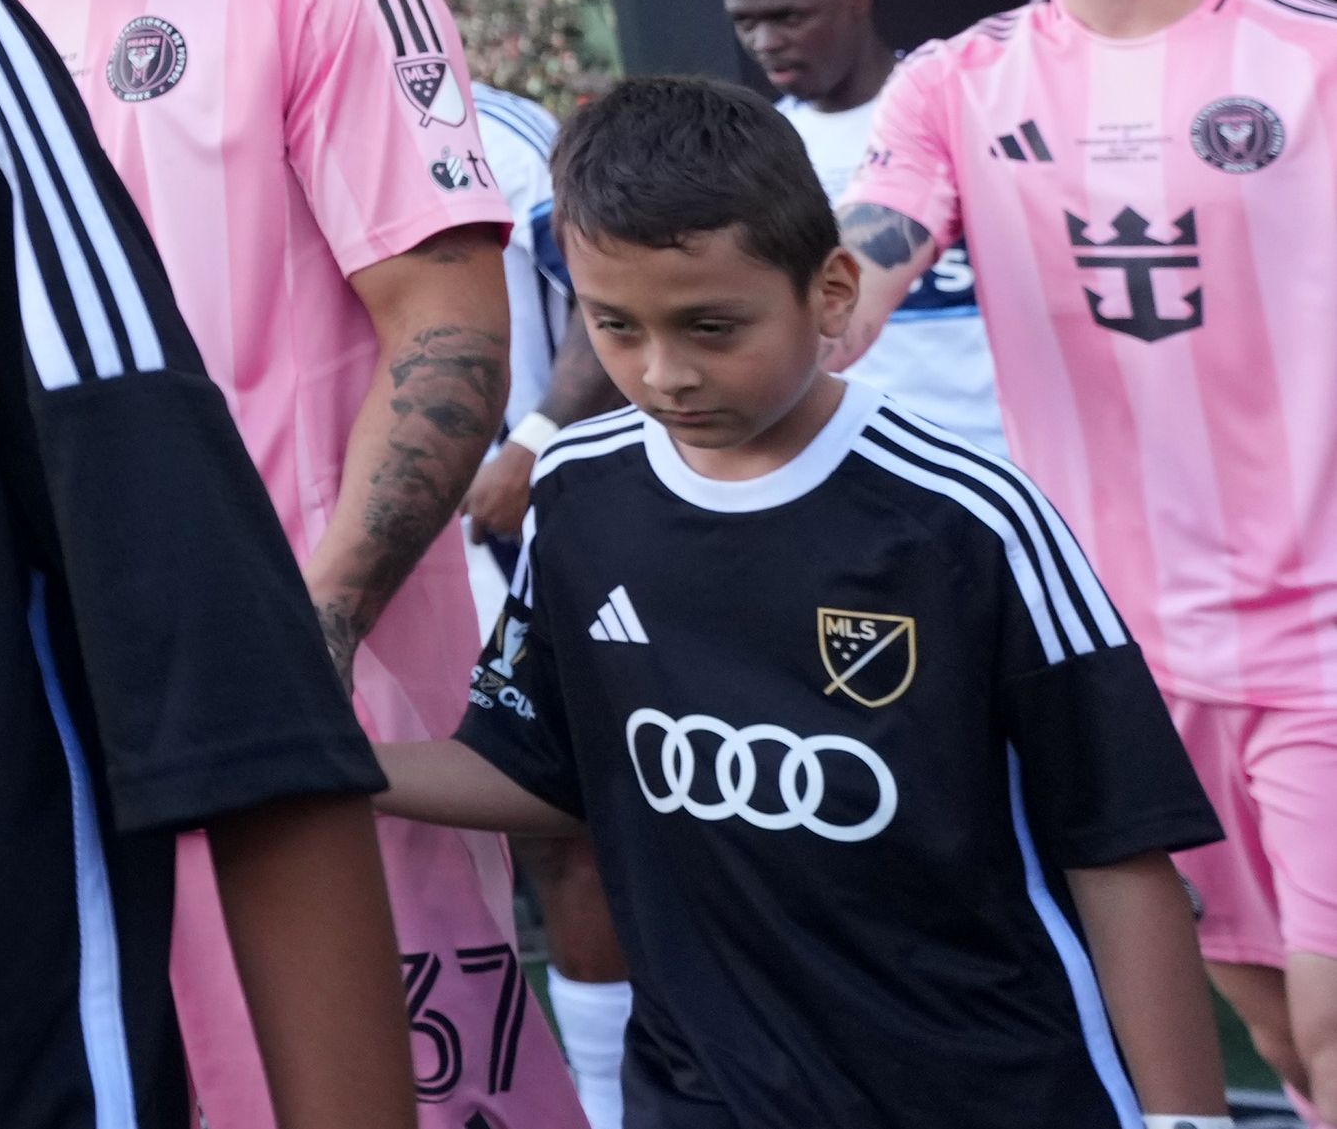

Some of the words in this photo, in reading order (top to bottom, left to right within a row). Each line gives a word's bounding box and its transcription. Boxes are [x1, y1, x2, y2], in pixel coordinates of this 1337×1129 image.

[402, 63, 441, 84] MLS
[825, 615, 878, 641] MLS
[401, 943, 527, 1104] 37
